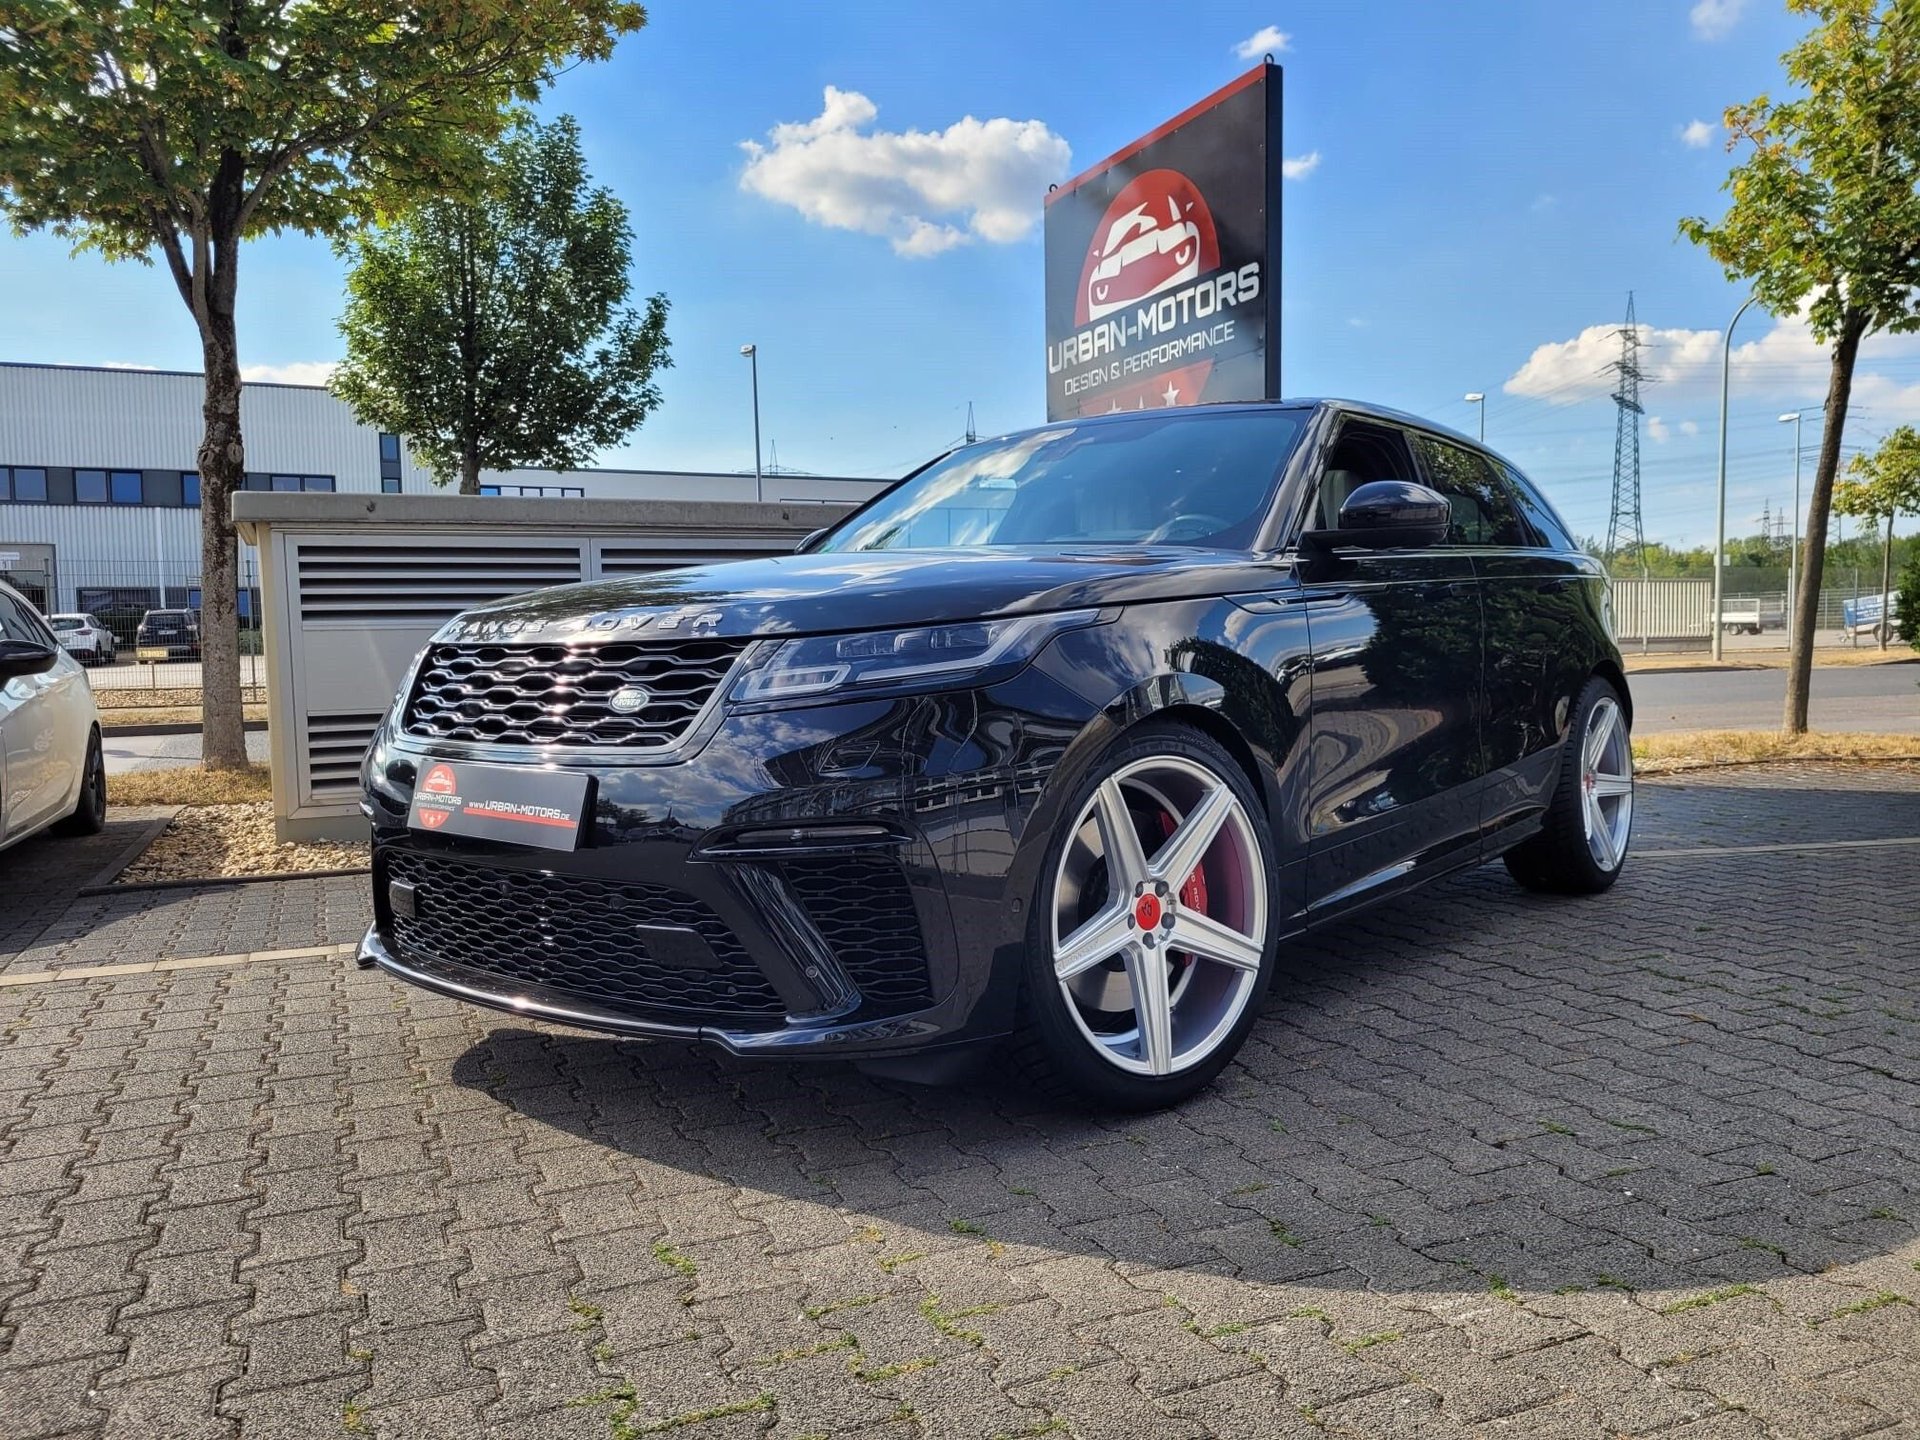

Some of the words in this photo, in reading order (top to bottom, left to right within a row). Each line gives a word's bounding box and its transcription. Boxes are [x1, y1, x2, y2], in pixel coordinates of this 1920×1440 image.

[1048, 261, 1260, 375] URBAN-MOTORS
[1064, 366, 1109, 396] DESIGN
[1110, 361, 1121, 380] &
[1123, 320, 1236, 376] PERFORMANCE
[449, 619, 549, 634] RANGE
[414, 791, 463, 805] URBAN-MOTORS
